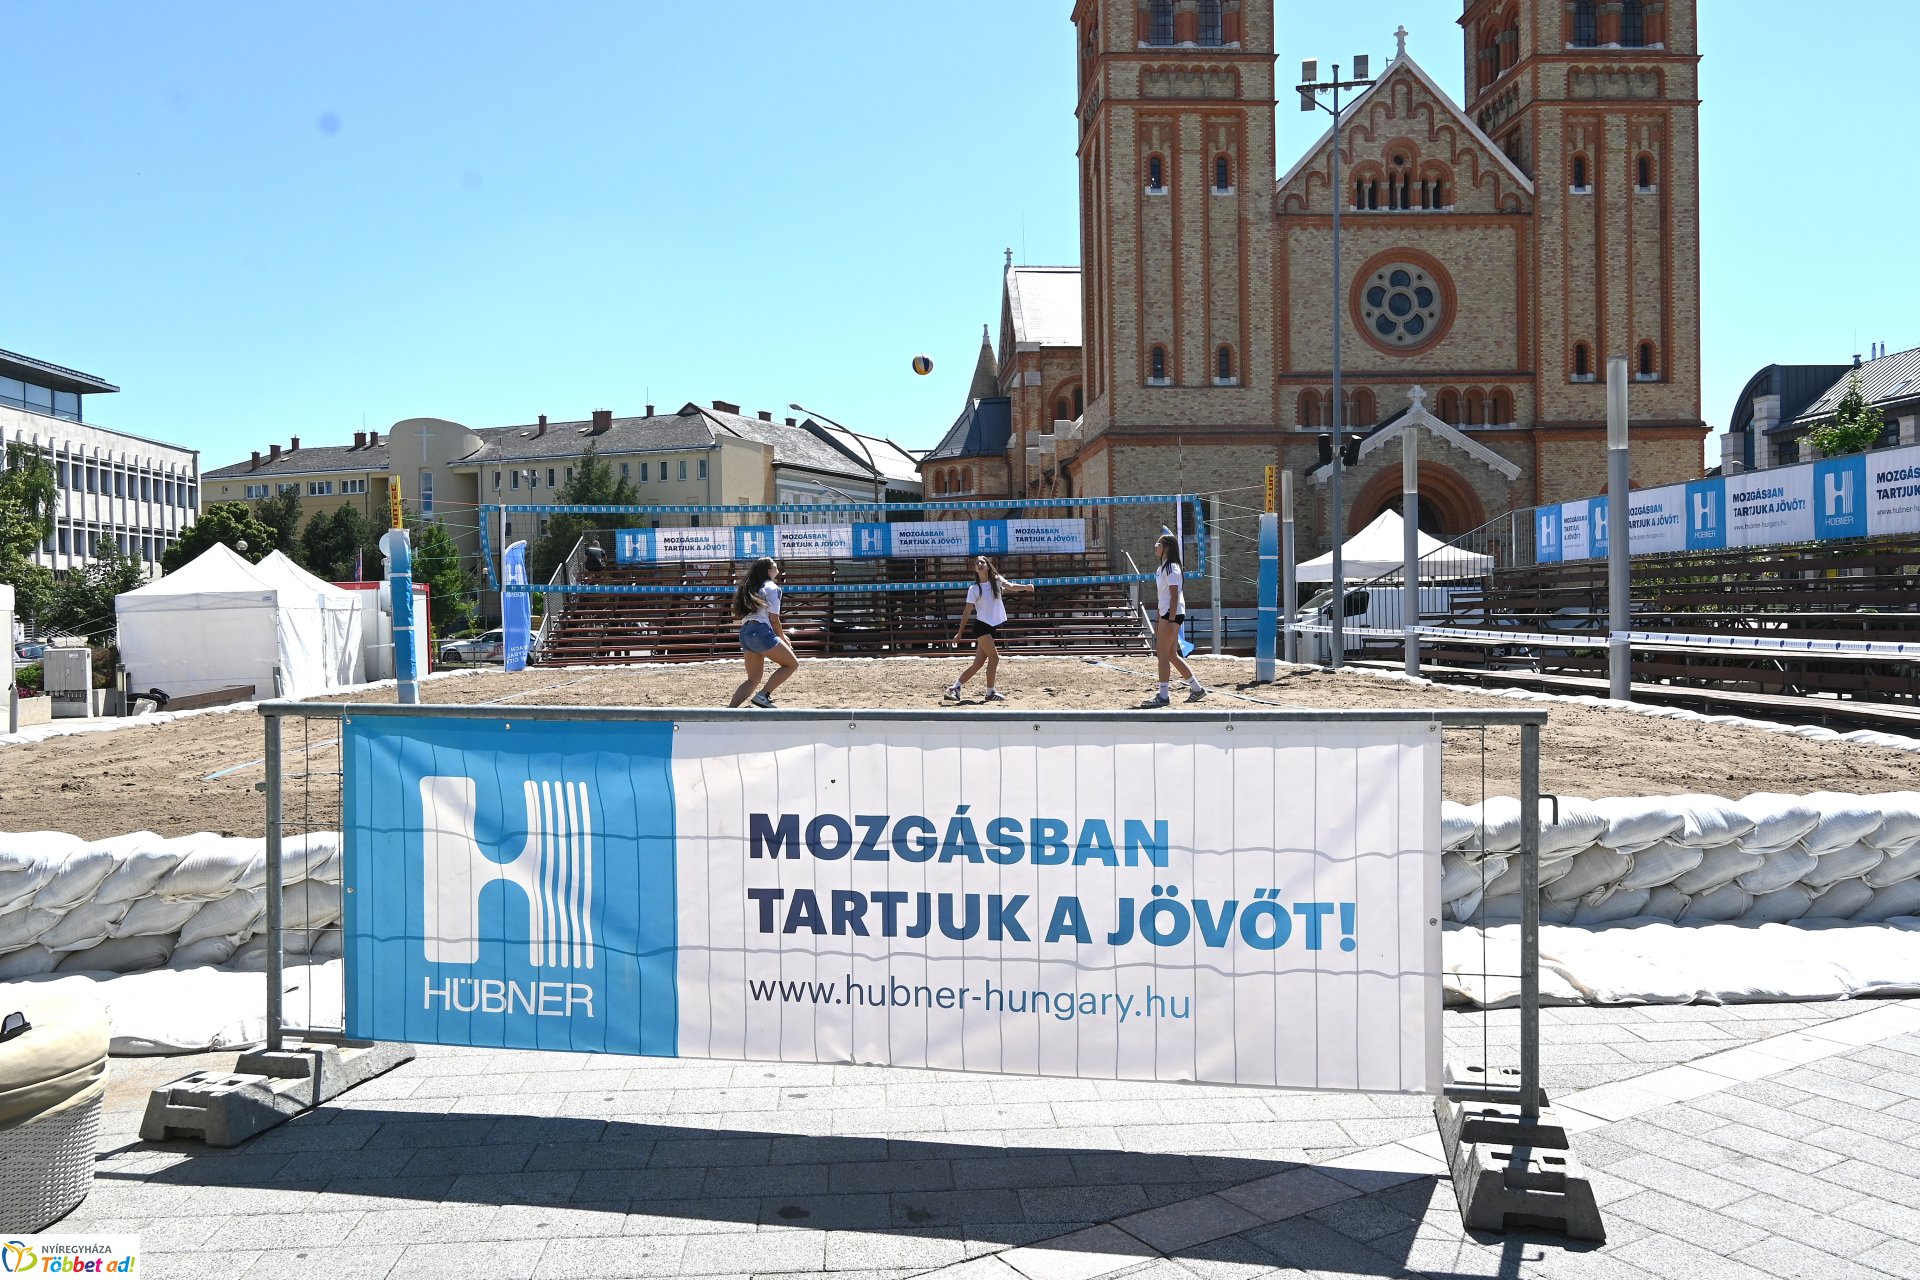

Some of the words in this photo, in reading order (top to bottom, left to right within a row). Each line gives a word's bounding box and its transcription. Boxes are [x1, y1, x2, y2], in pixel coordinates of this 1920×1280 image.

[1877, 466, 1920, 483] MOZGÁS
[1733, 487, 1784, 503] MOZGÁSBAN
[1877, 485, 1920, 500] TARTJUK
[1629, 504, 1663, 516] OZGÁSBAN
[1734, 504, 1767, 517] TARTJUK
[1767, 503, 1774, 513] A
[1015, 527, 1060, 535] MOZGÁSBAN
[1629, 519, 1651, 529] ARTJUK
[749, 804, 1170, 868] MOZGÁSBAN
[748, 887, 1032, 942] TARTJUK
[1045, 896, 1093, 944] A
[1107, 884, 1357, 952] JÖVŐT!
[423, 976, 595, 1018] HÜBNER
[749, 973, 1190, 1023] www.hubner-hungary.hu
